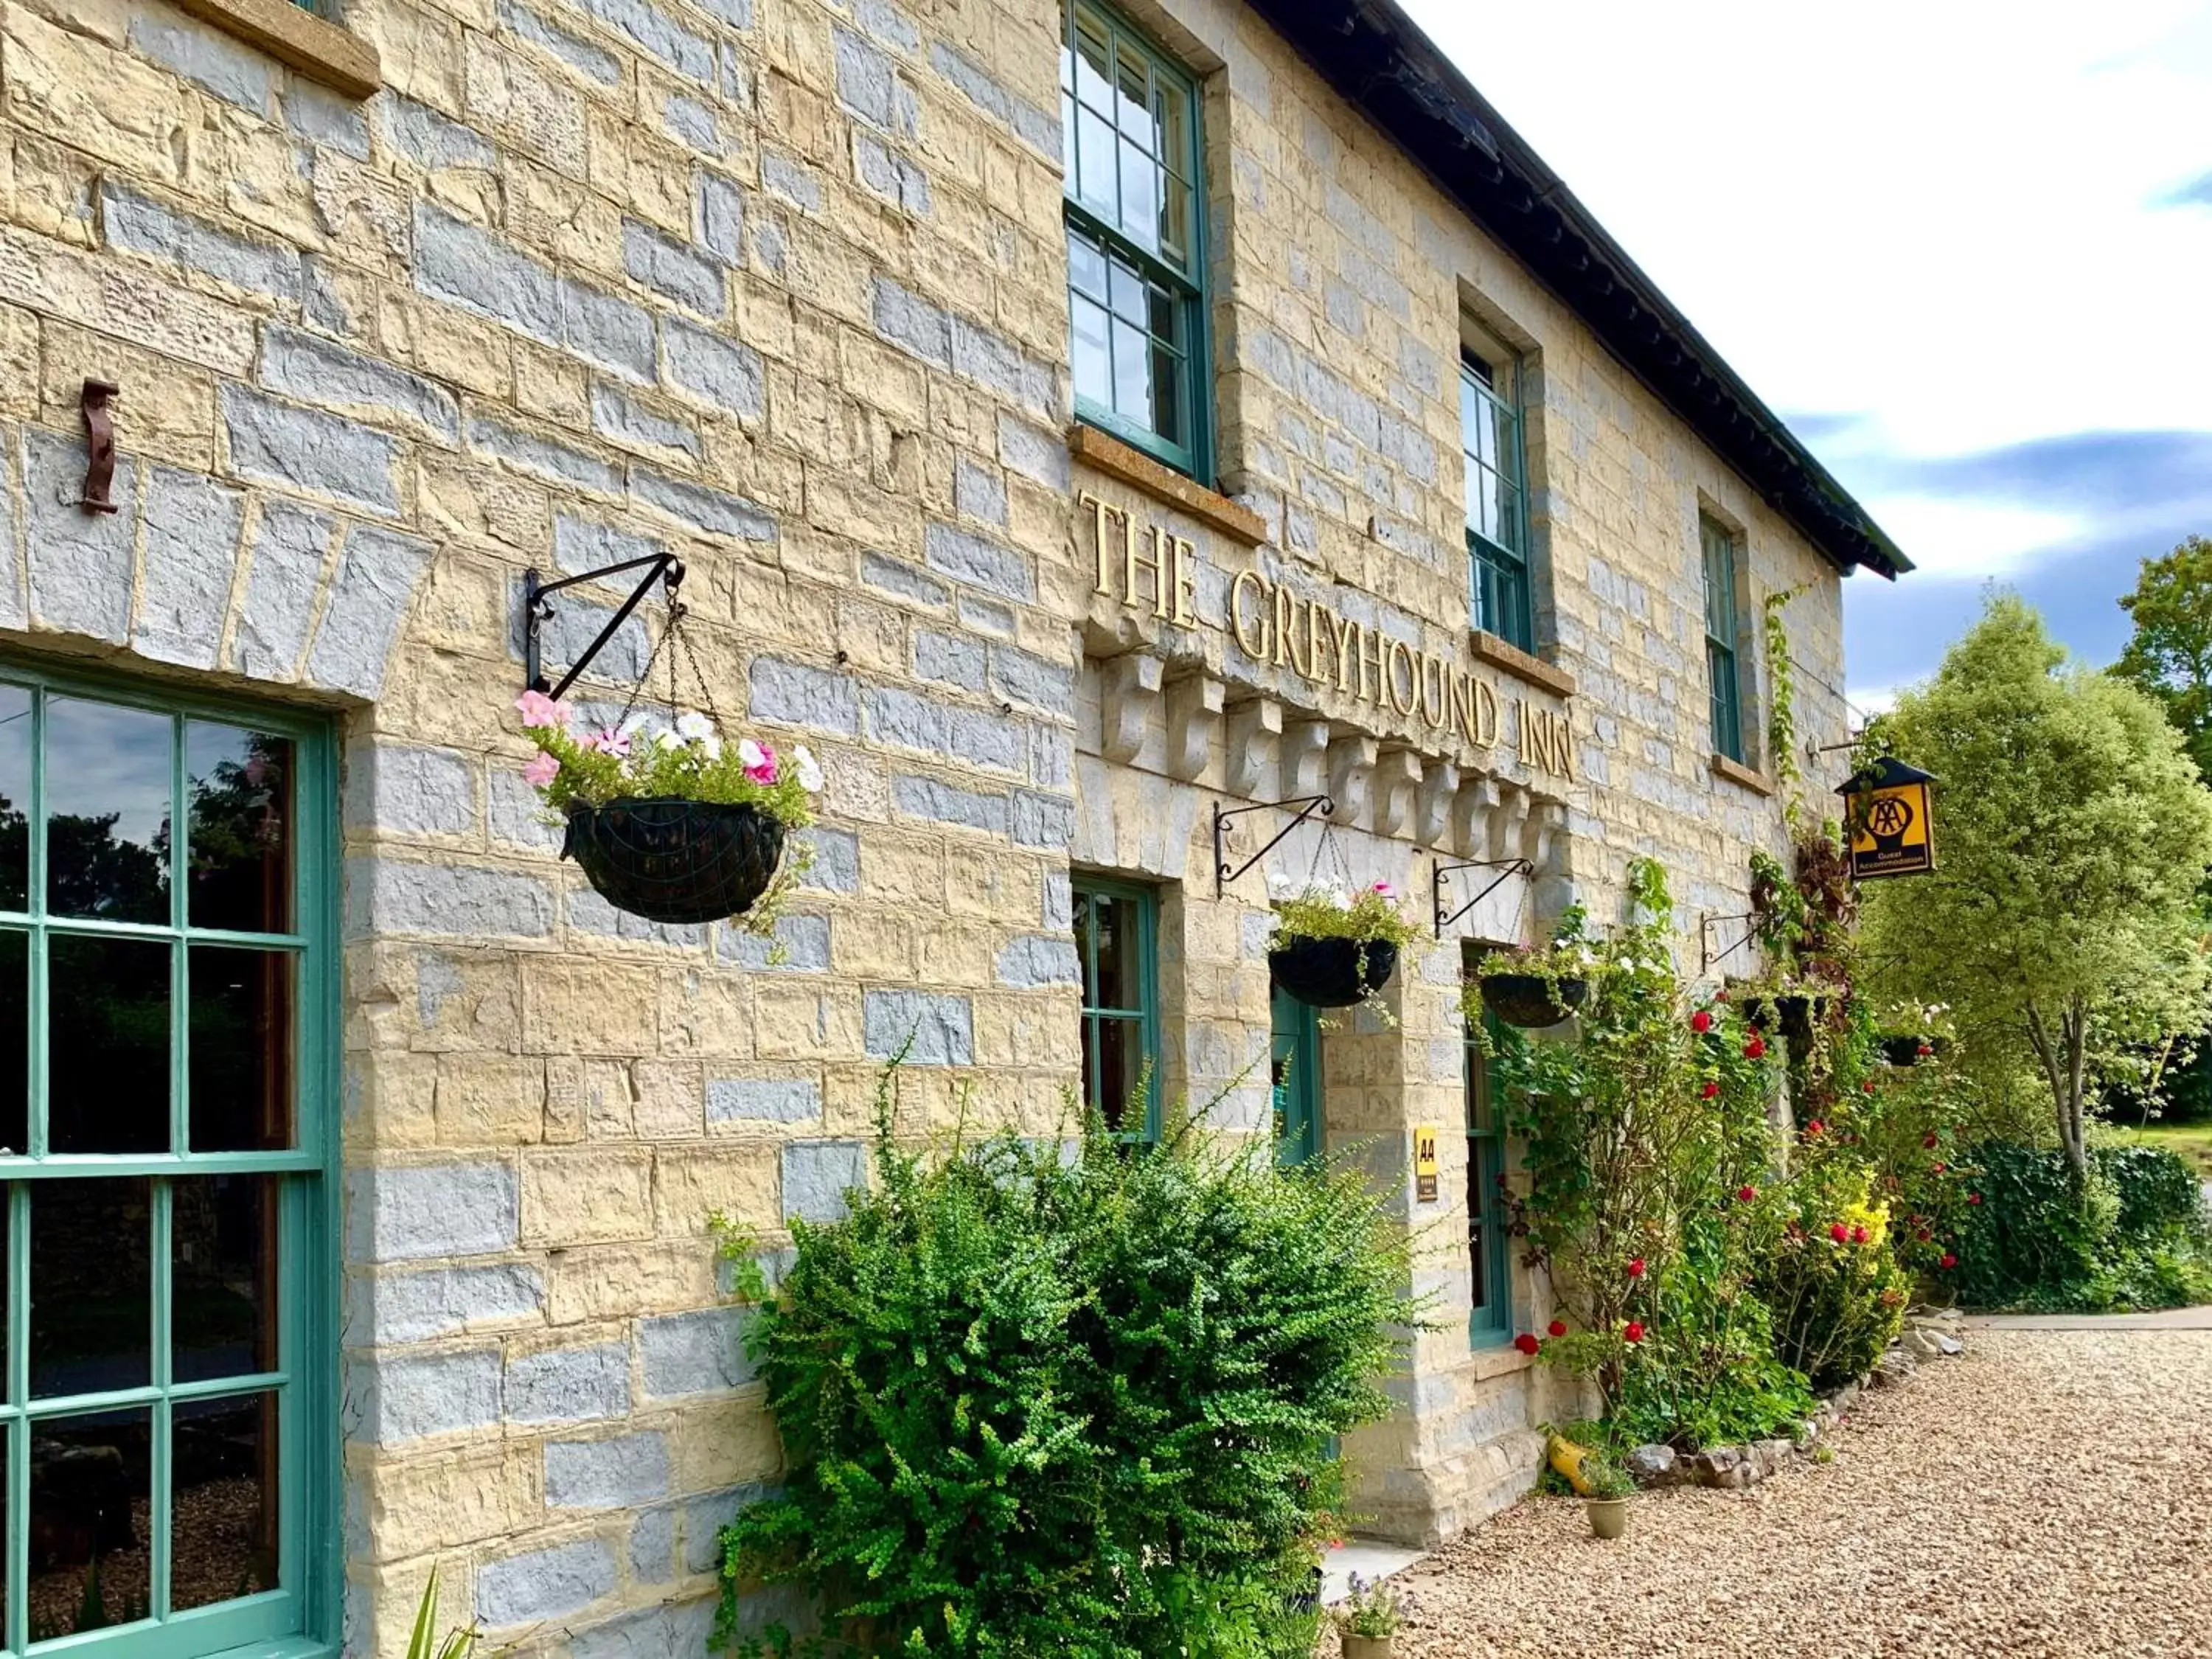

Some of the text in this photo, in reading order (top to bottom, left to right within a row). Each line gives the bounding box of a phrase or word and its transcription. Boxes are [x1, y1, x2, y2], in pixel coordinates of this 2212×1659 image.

[1079, 490, 1576, 782] THE GREYHOUND INN
[1874, 800, 1903, 832] AA
[1878, 851, 1902, 859] Guest
[1420, 1139, 1434, 1162] AA
